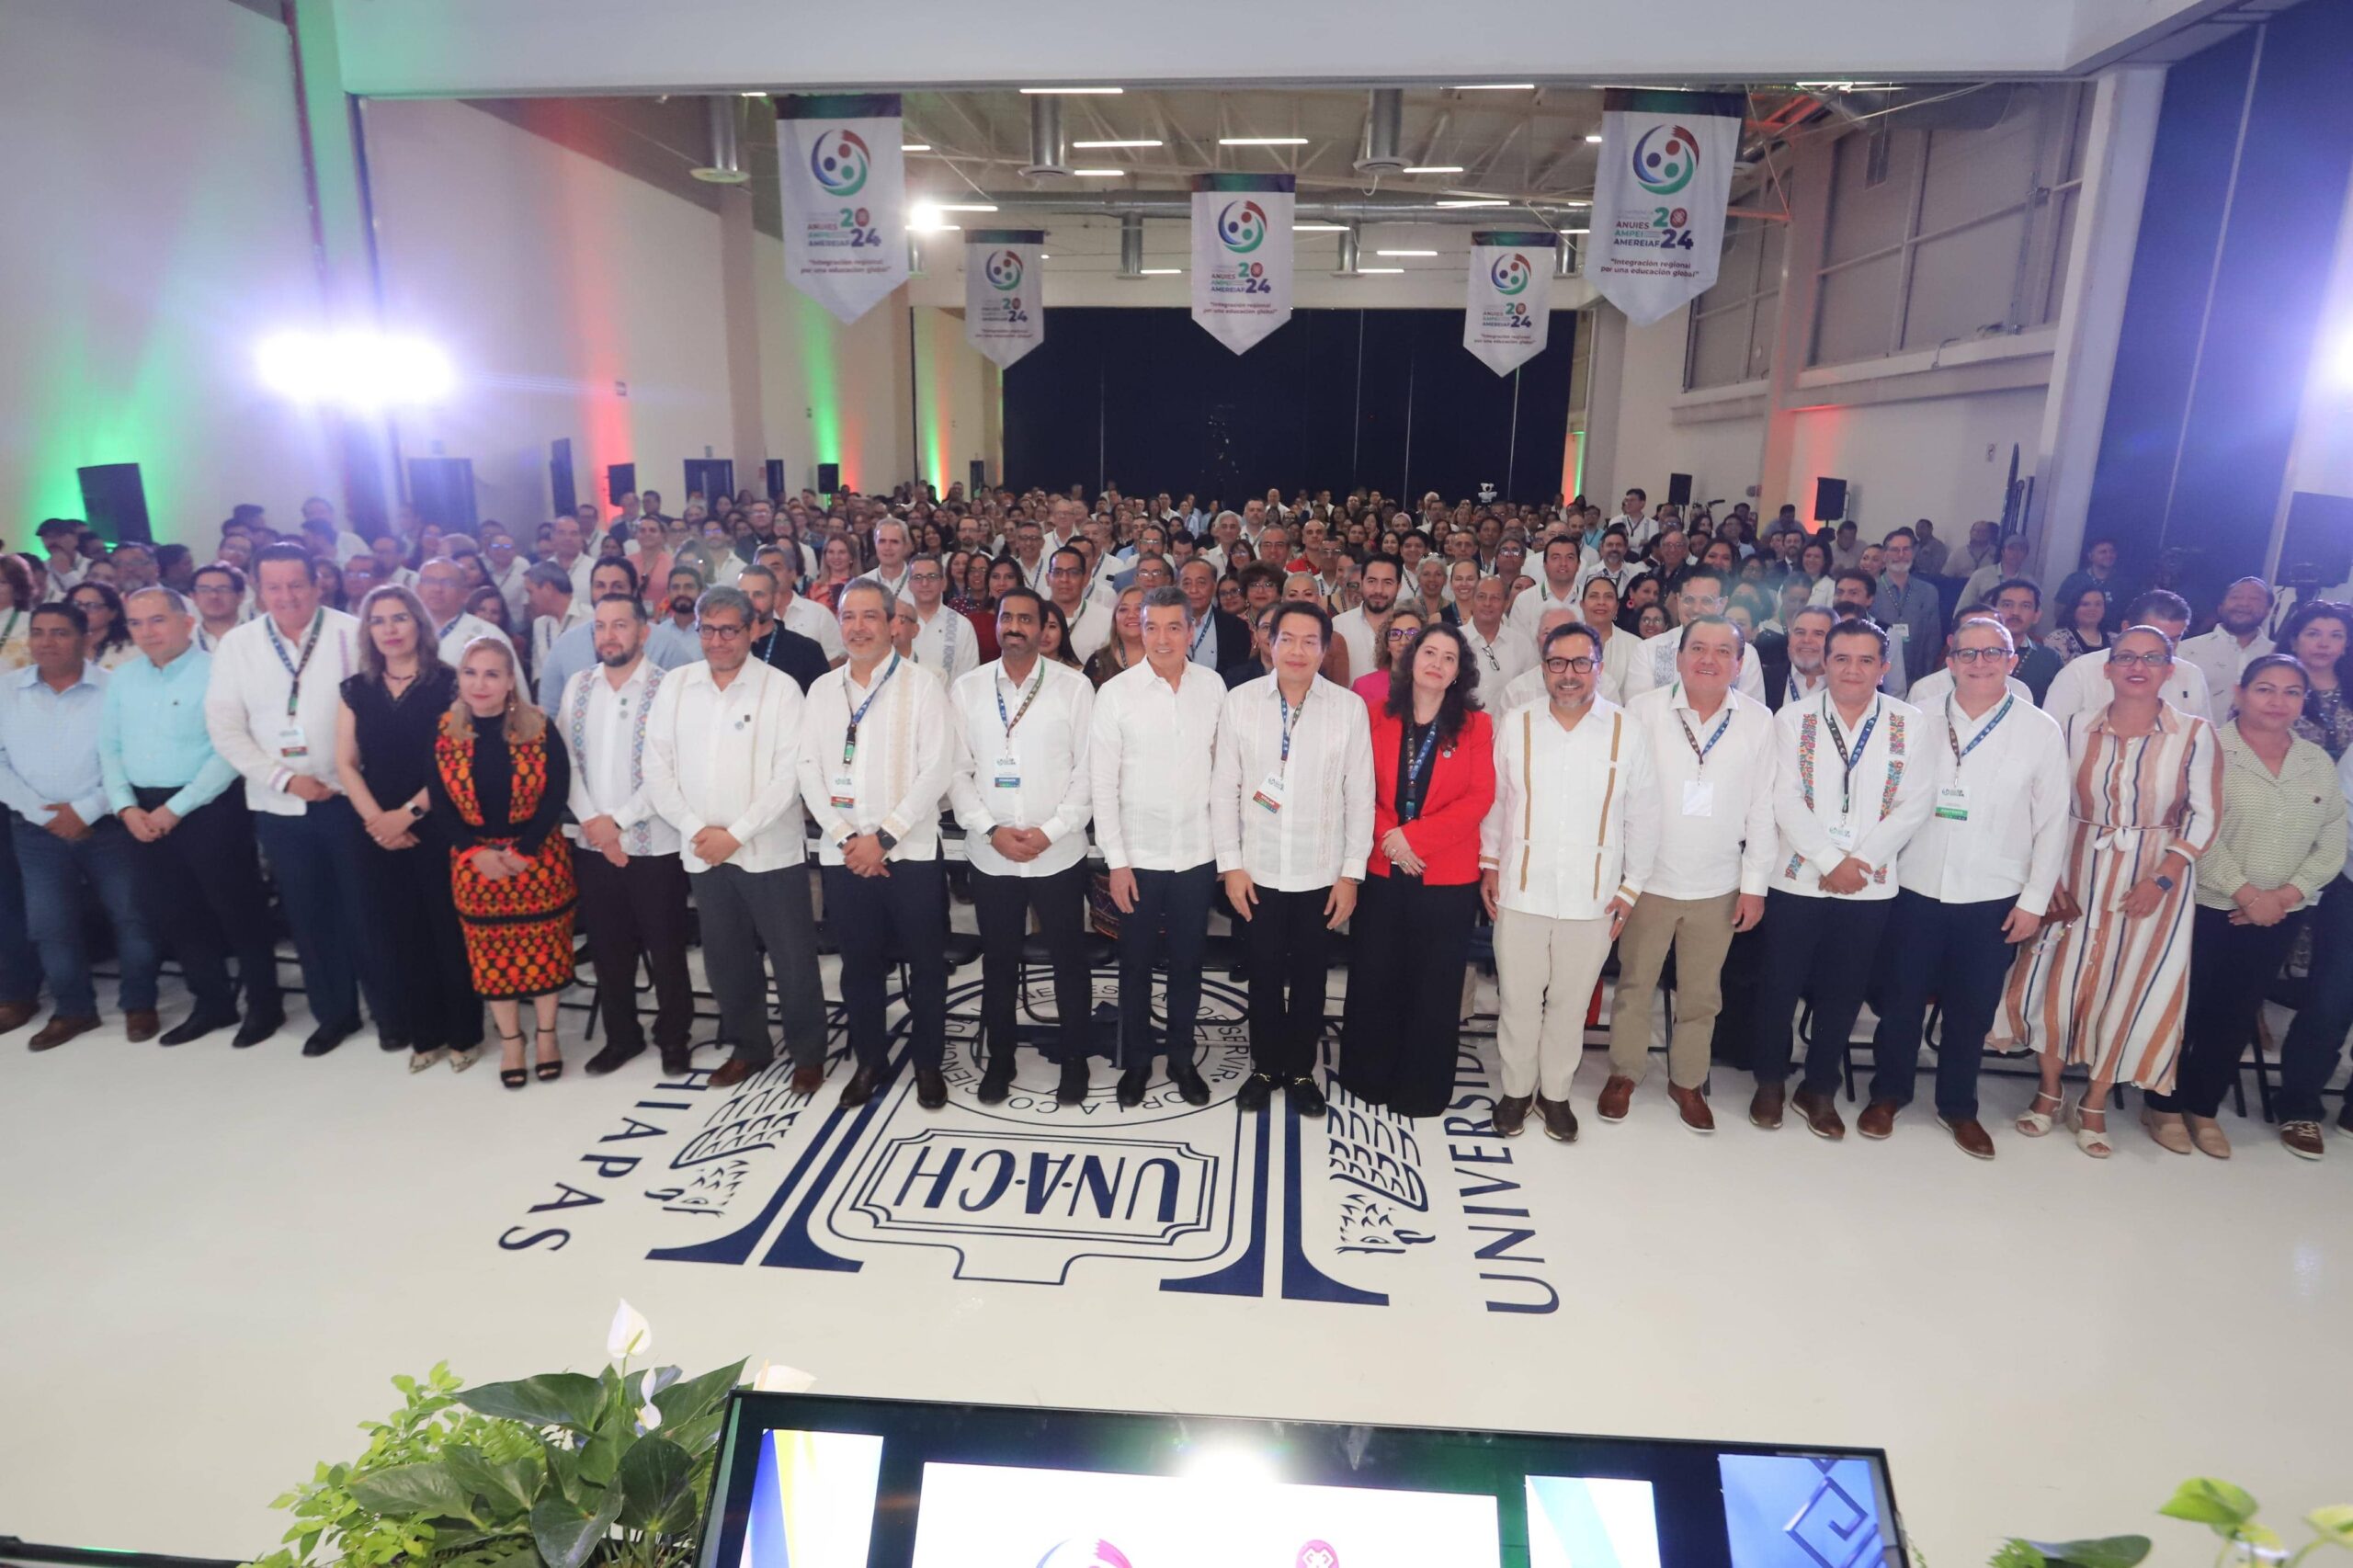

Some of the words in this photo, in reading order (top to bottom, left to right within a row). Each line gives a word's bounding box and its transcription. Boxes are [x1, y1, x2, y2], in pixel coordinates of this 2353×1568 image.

[839, 208, 870, 228] 20
[1653, 207, 1688, 228] 20
[1616, 221, 1650, 230] ANUIES
[850, 228, 881, 247] 24
[1615, 230, 1643, 238] AMPEI
[1660, 228, 1694, 250] 24
[1613, 238, 1660, 247] AMEREIAF
[1238, 262, 1264, 278] 20
[1660, 261, 1690, 269] regional
[1631, 267, 1671, 277] educación
[1245, 278, 1271, 294] 24
[1002, 298, 1021, 311] 20
[1505, 302, 1527, 315] 20
[1008, 310, 1029, 323] 24
[1510, 315, 1532, 328] 24
